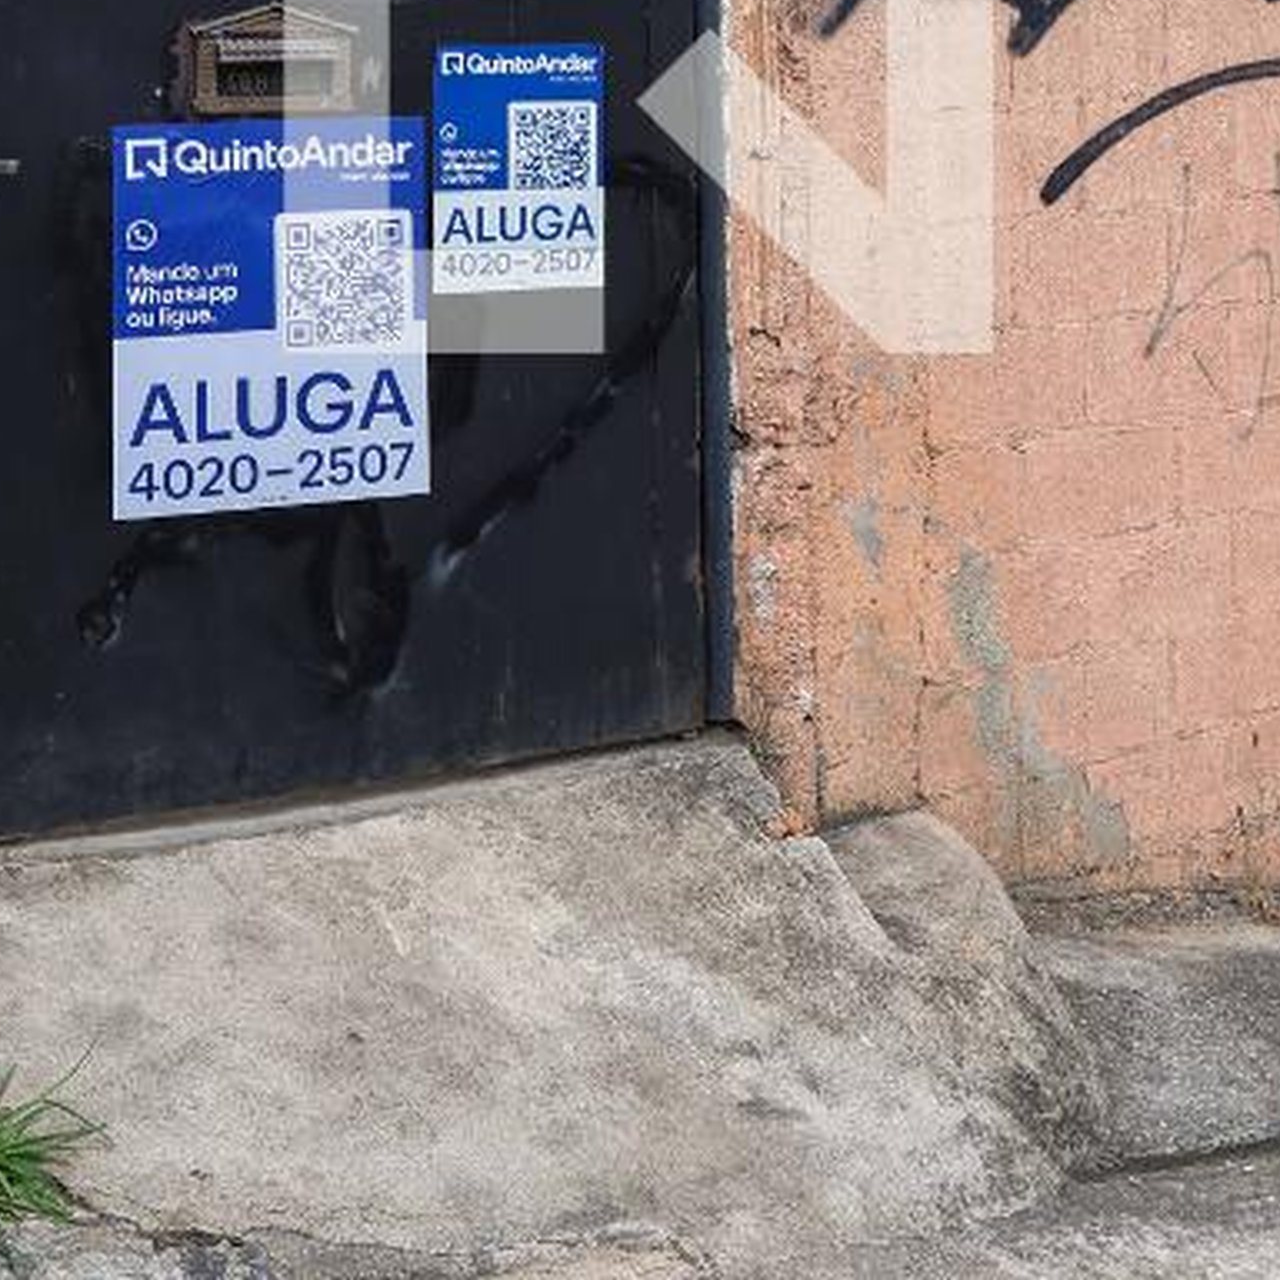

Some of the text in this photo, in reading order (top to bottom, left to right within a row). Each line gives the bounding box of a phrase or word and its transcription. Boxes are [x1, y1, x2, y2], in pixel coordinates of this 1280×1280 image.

[465, 52, 598, 75] QuintoAndar
[173, 133, 414, 175] QuintoAndar
[441, 204, 595, 244] ALUGA
[441, 248, 596, 277] 4020-2507
[125, 311, 154, 328] ou
[129, 369, 414, 447] ALUGA
[129, 441, 415, 501] 4020-2507
